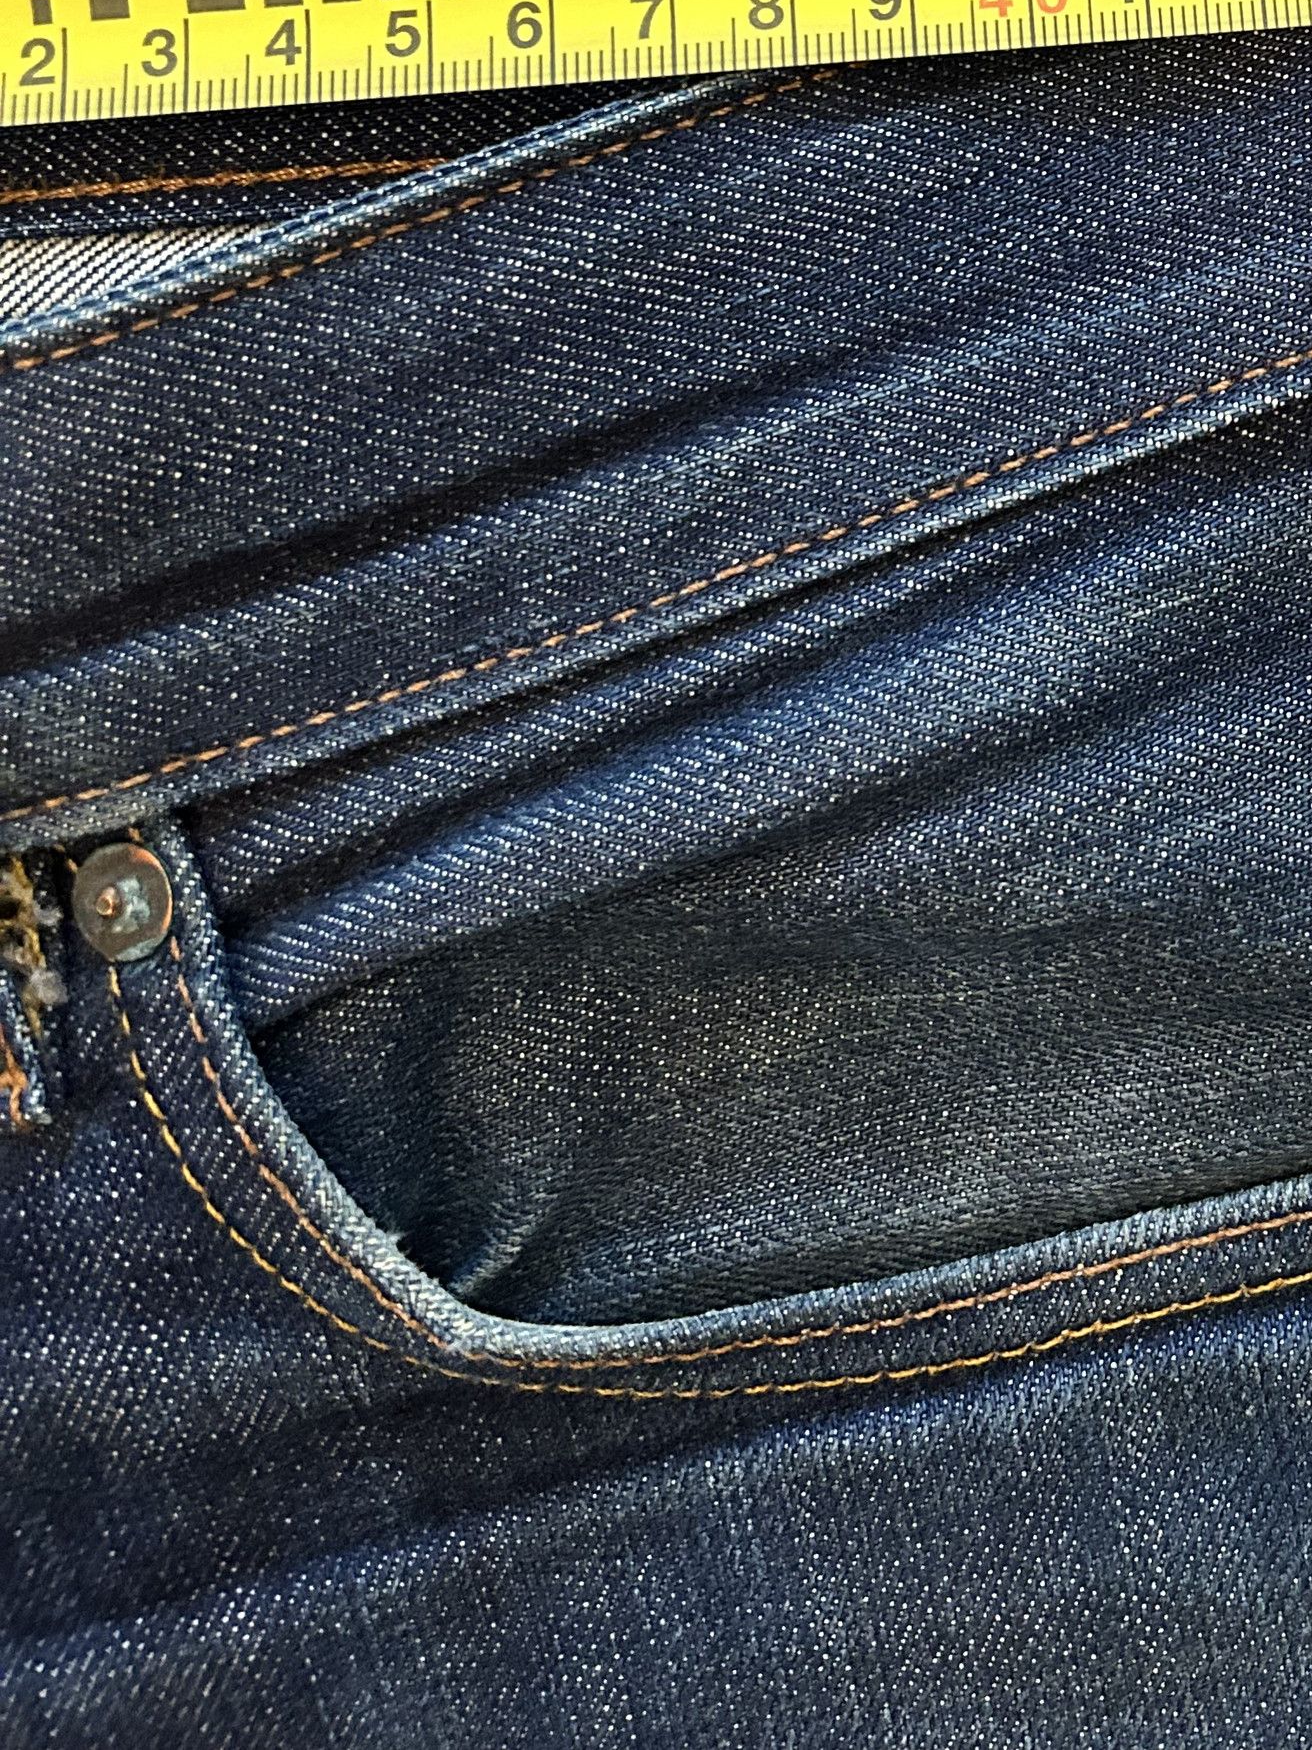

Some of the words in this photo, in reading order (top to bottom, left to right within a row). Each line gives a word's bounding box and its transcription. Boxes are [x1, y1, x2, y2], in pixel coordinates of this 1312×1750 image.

[19, 38, 55, 86] 2
[141, 29, 178, 77] 3
[265, 19, 302, 66] 4
[386, 10, 422, 57] 5
[507, 1, 543, 49] 6
